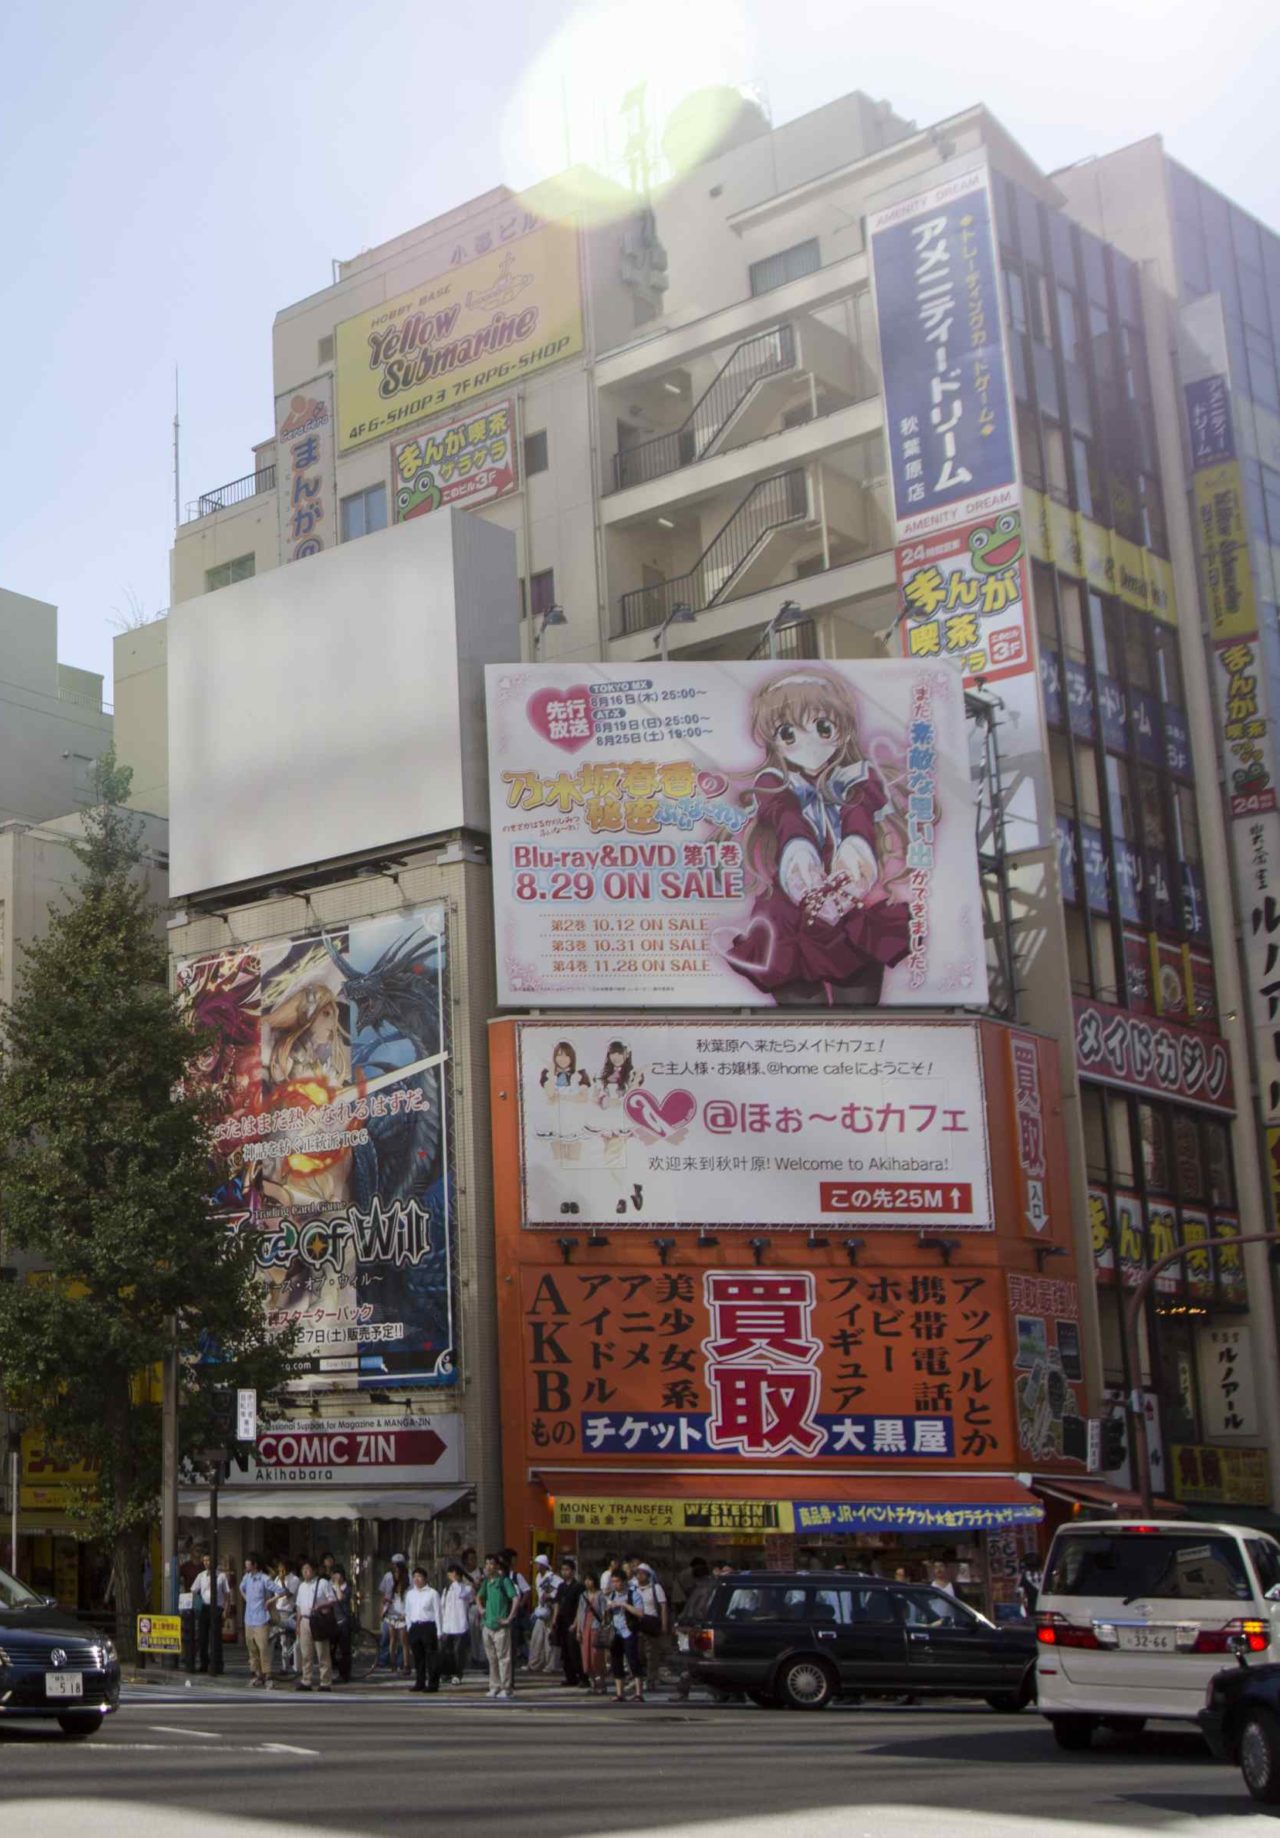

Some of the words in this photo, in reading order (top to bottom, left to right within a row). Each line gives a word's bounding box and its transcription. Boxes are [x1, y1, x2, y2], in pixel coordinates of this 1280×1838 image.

[370, 302, 412, 327] HOBBY
[419, 283, 451, 304] BASE
[367, 303, 461, 371] Yellow
[379, 304, 540, 400] Submarine
[910, 214, 973, 492] アメニティードリーム
[397, 409, 509, 483] まんが喫茶
[904, 504, 958, 534] AMENITY
[966, 491, 1012, 513] DREAM
[903, 566, 1020, 616] まんが
[909, 612, 980, 657] 喫茶
[993, 641, 1022, 661] 3F
[593, 681, 630, 694] TOKYO
[632, 680, 650, 690] MX
[546, 699, 587, 721] 先行
[548, 720, 590, 739] 放送
[514, 844, 676, 869] Blu-ray&DVD
[683, 843, 742, 868] 第1巻
[516, 872, 594, 900] 8.29
[603, 872, 650, 900] ON
[660, 870, 744, 899] SALE
[551, 918, 587, 932] 第2巻
[593, 919, 634, 931] 10.12
[640, 919, 663, 931] ON
[668, 918, 709, 931] SALE
[551, 939, 587, 952] 第3巻
[593, 939, 635, 952] 10.31
[641, 939, 664, 952] ON
[669, 939, 711, 951] SALE
[553, 960, 588, 972] 第4巻
[594, 960, 638, 972] 11.28
[642, 960, 665, 972] ON
[671, 959, 711, 972] SALE
[1077, 1009, 1227, 1098] メイドカジノ
[648, 1156, 770, 1172] 欢迎来到秋叶原!
[775, 1157, 843, 1171] Welcome
[848, 1158, 863, 1171] to
[870, 1157, 949, 1171] Akihabara!
[253, 1205, 290, 1220] Trading
[313, 1200, 347, 1214] Game
[830, 1187, 943, 1208] この先25M
[1030, 1183, 1042, 1219] 入口
[347, 1197, 431, 1266] Will
[577, 1273, 618, 1405] アイドル
[617, 1274, 656, 1370] アニメ
[867, 1276, 902, 1373] ホビー
[526, 1272, 572, 1413] AKB
[656, 1273, 699, 1409] 美少女系
[827, 1276, 868, 1412] フィギュア
[908, 1275, 952, 1413] 携帯電話
[703, 1271, 826, 1456] 買取
[951, 1277, 998, 1457] アップルとか
[1217, 1346, 1246, 1432] ルノアール
[325, 1420, 336, 1430] for
[338, 1418, 375, 1430] Magazine
[585, 1416, 702, 1450] チケット
[831, 1417, 948, 1453] 大黒屋
[258, 1435, 349, 1465] COMIC
[357, 1435, 396, 1463] ZIN
[256, 1468, 333, 1481] Akihabara
[560, 1504, 604, 1514] MONEY
[610, 1504, 673, 1514] TRANSFER
[685, 1503, 764, 1516] WESTERN
[710, 1515, 764, 1527] UNION
